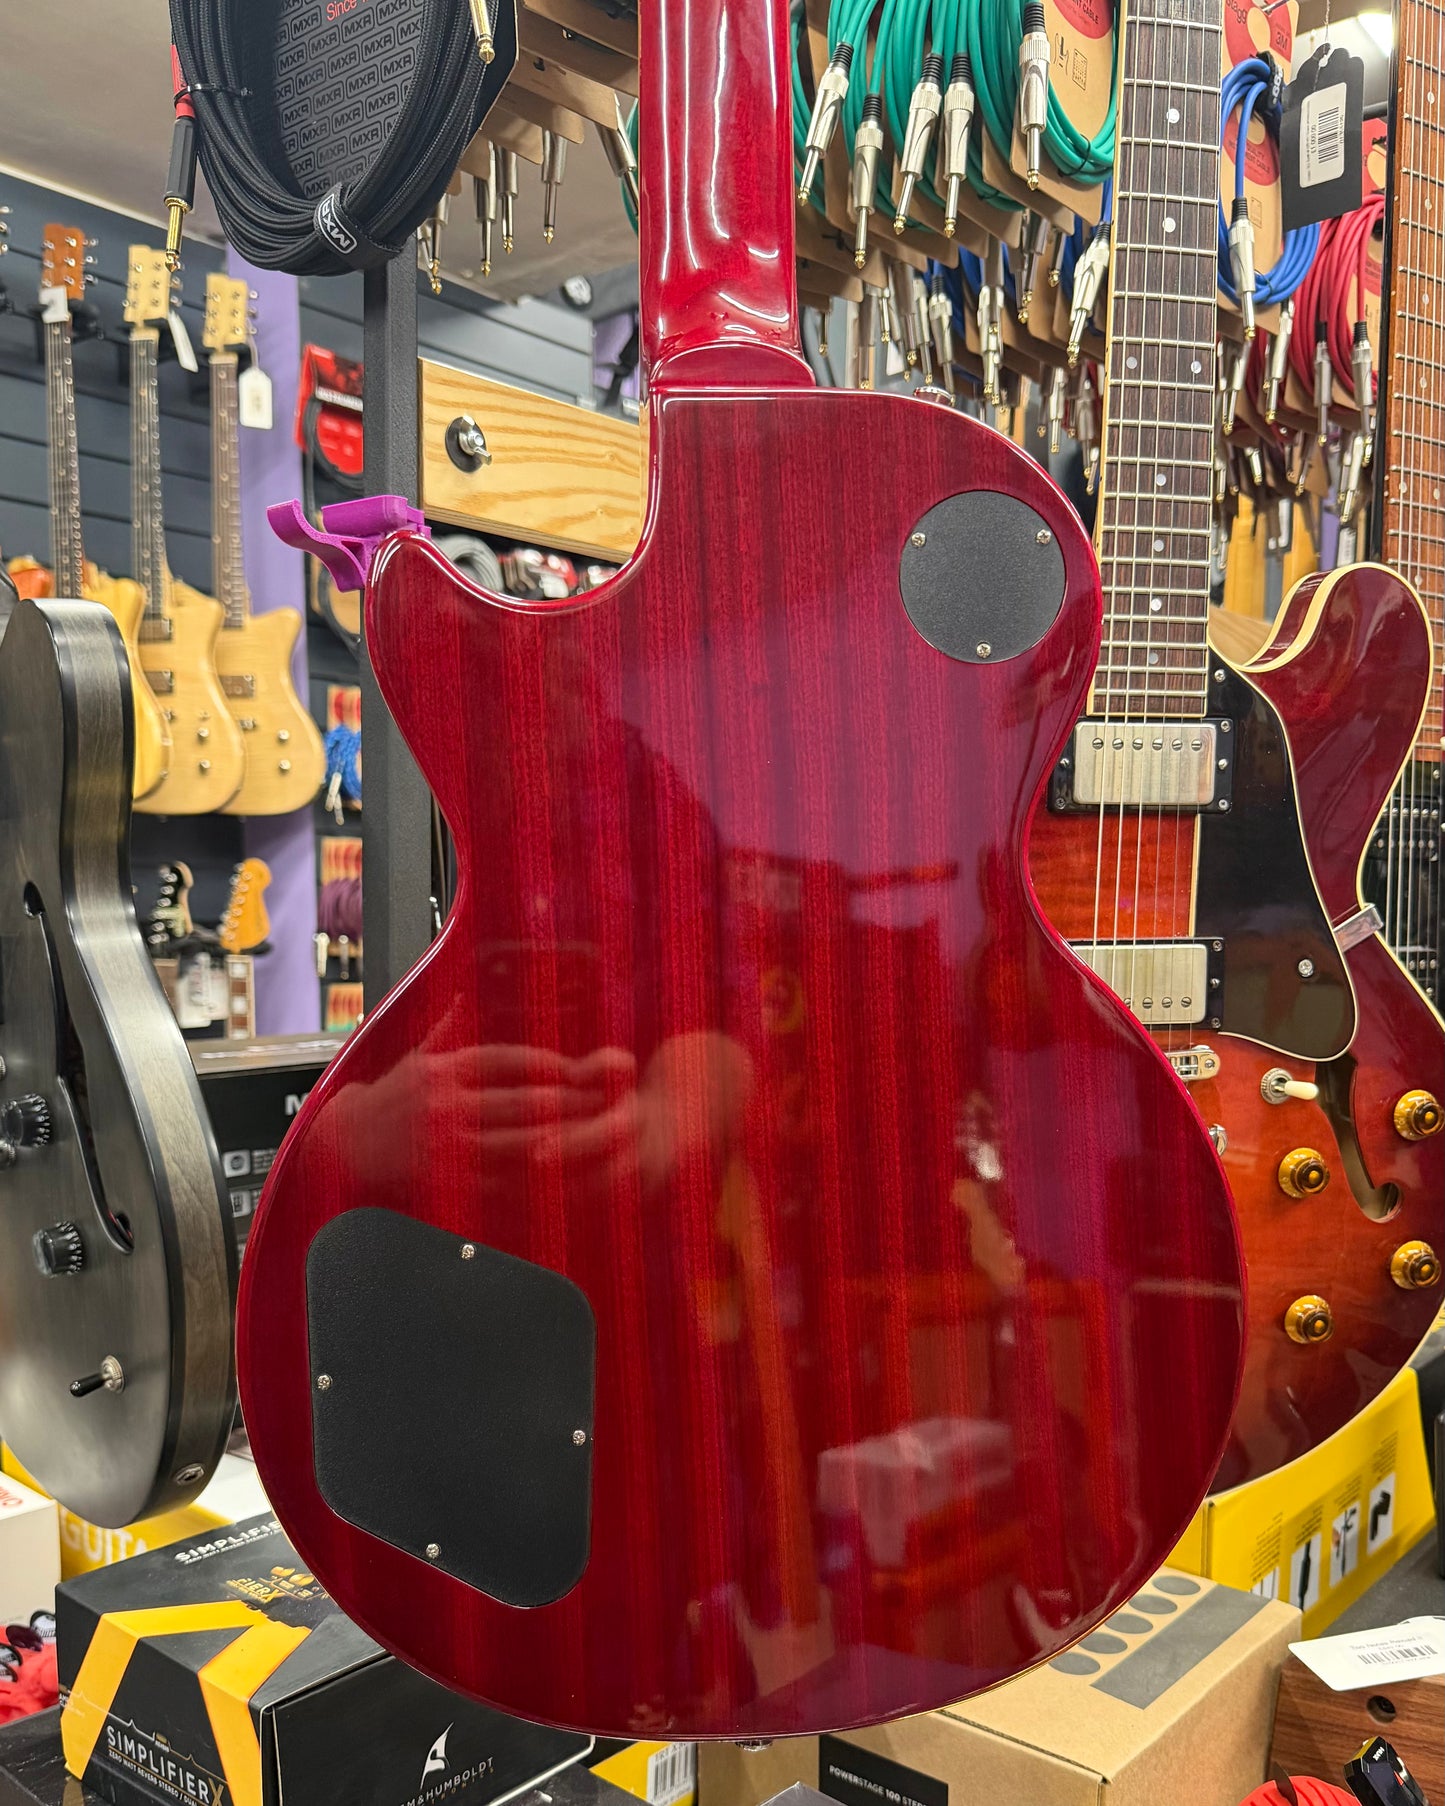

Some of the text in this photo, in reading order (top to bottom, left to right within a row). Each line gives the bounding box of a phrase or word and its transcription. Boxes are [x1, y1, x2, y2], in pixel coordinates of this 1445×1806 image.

[327, 0, 357, 20] Since
[379, 0, 408, 20] MXR
[294, 12, 319, 35] MXR
[344, 14, 372, 37] MXR
[400, 19, 421, 39] MX
[311, 31, 337, 54] MXR
[364, 33, 392, 56] MXR
[280, 49, 305, 71] MXR
[330, 51, 357, 73] MXR
[383, 54, 412, 76] MXR
[298, 68, 323, 90] MXR
[349, 71, 376, 93] MXR
[276, 84, 292, 100] XR
[315, 87, 341, 109] MXR
[368, 91, 395, 113] MXR
[334, 107, 360, 129] MXR
[302, 122, 328, 144] MXR
[352, 127, 379, 149] MXR
[319, 142, 345, 164] MXR
[305, 177, 331, 197] MXR
[322, 200, 351, 248] MXR
[829, 1765, 885, 1796] POWERSTAGE
[885, 1789, 901, 1805] 100
